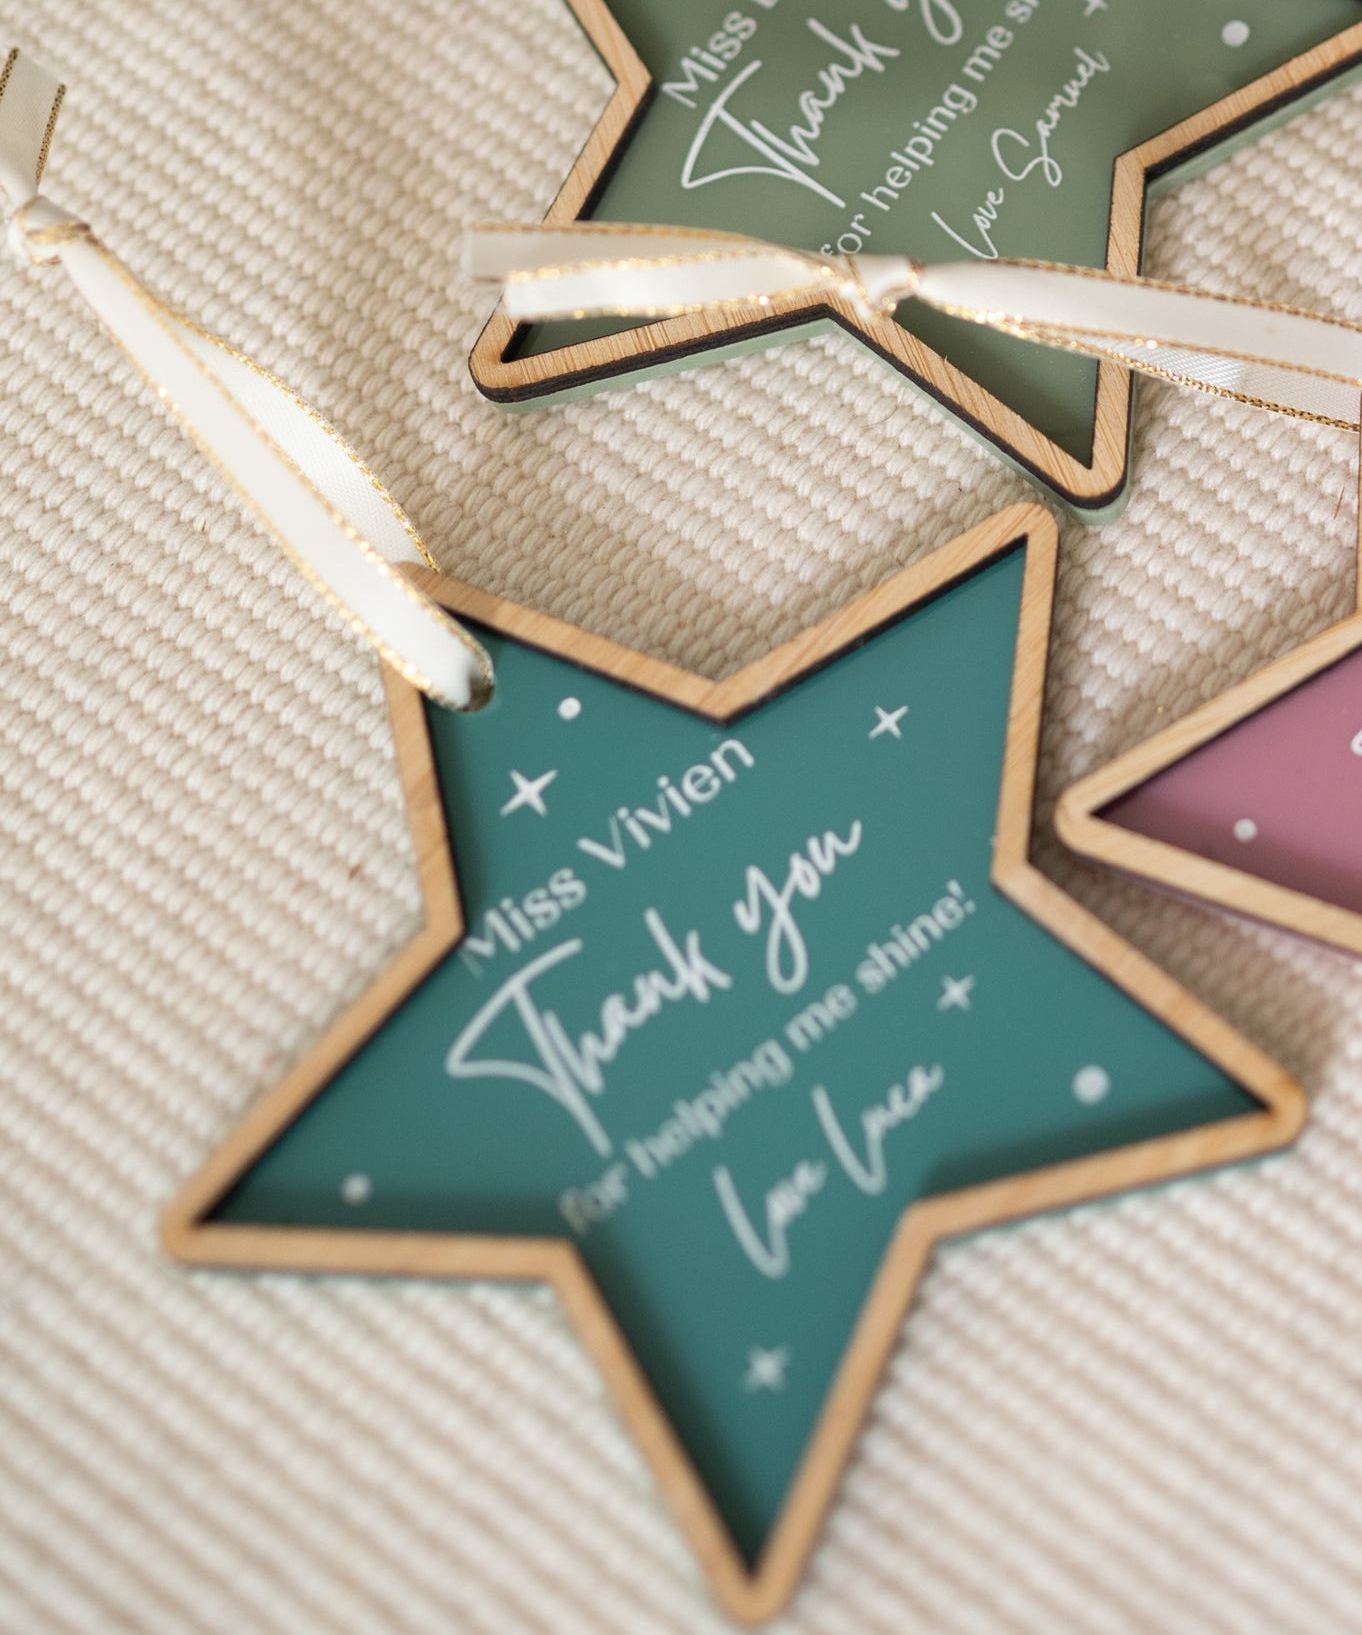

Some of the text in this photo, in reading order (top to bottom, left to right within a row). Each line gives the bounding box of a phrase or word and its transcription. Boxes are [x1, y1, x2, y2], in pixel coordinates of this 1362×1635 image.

[662, 11, 757, 108] Miss
[681, 18, 900, 207] Thank
[861, 81, 977, 211] helping
[962, 24, 1013, 82] me
[932, 47, 1111, 259] Love Samuel
[458, 738, 755, 978] Miss Vivien
[445, 820, 862, 1158] Thank you
[558, 879, 976, 1233] for helping me shine!
[713, 1064, 944, 1279] Love Luca
